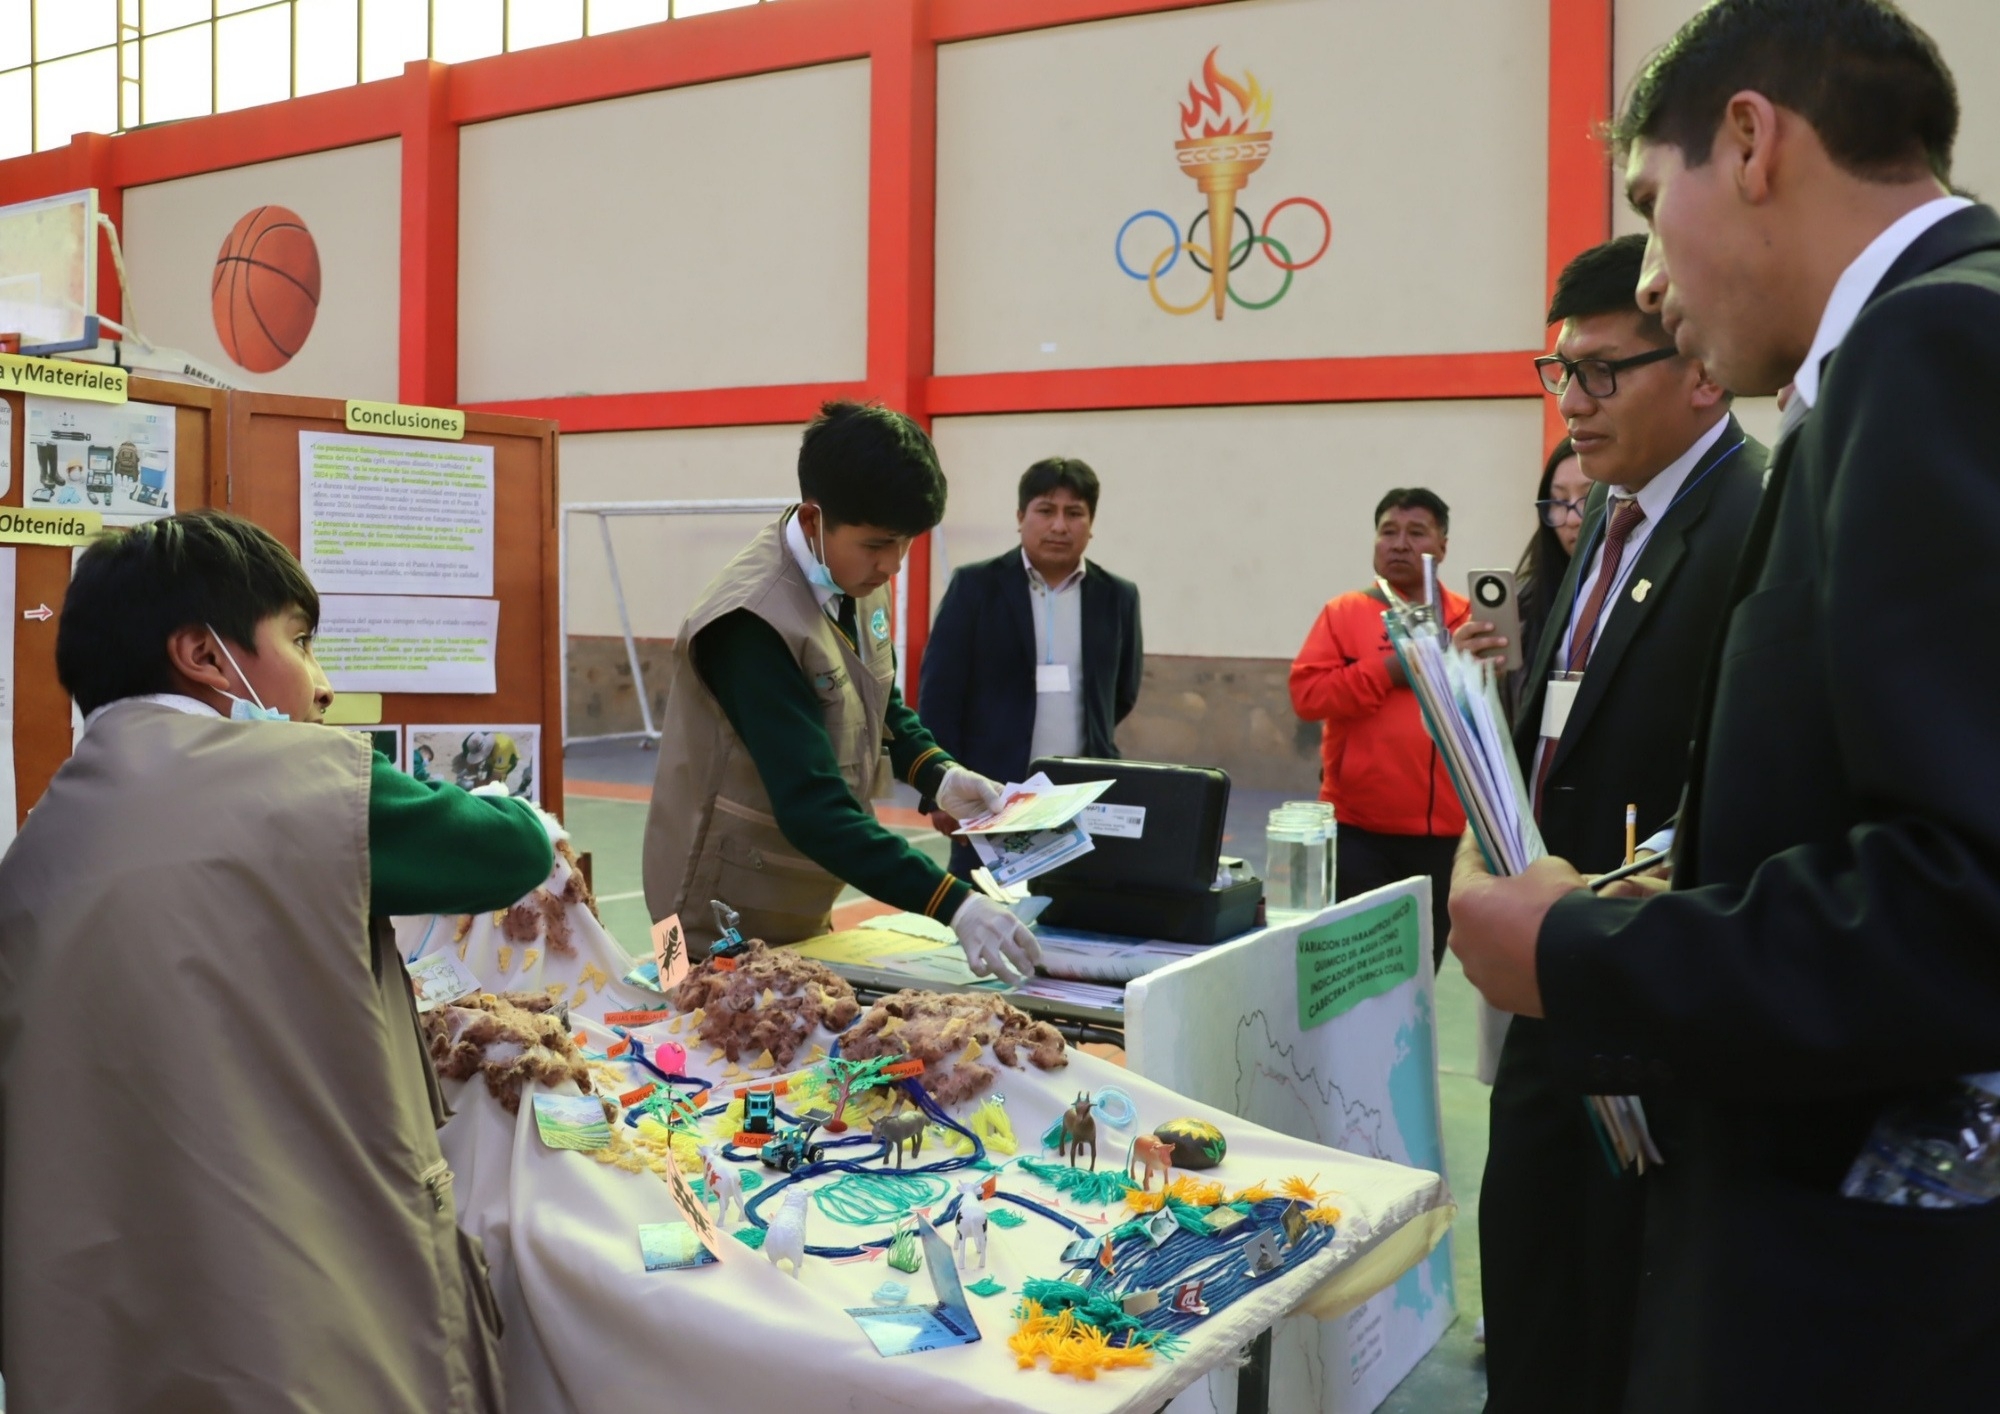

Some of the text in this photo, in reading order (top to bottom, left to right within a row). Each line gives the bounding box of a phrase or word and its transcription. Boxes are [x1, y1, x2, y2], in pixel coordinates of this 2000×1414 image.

[11, 367, 22, 385] y
[25, 363, 123, 391] Materiales
[351, 407, 458, 431] Conclusiones
[0, 515, 85, 536] Obtenida
[1299, 940, 1340, 954] VARIACION
